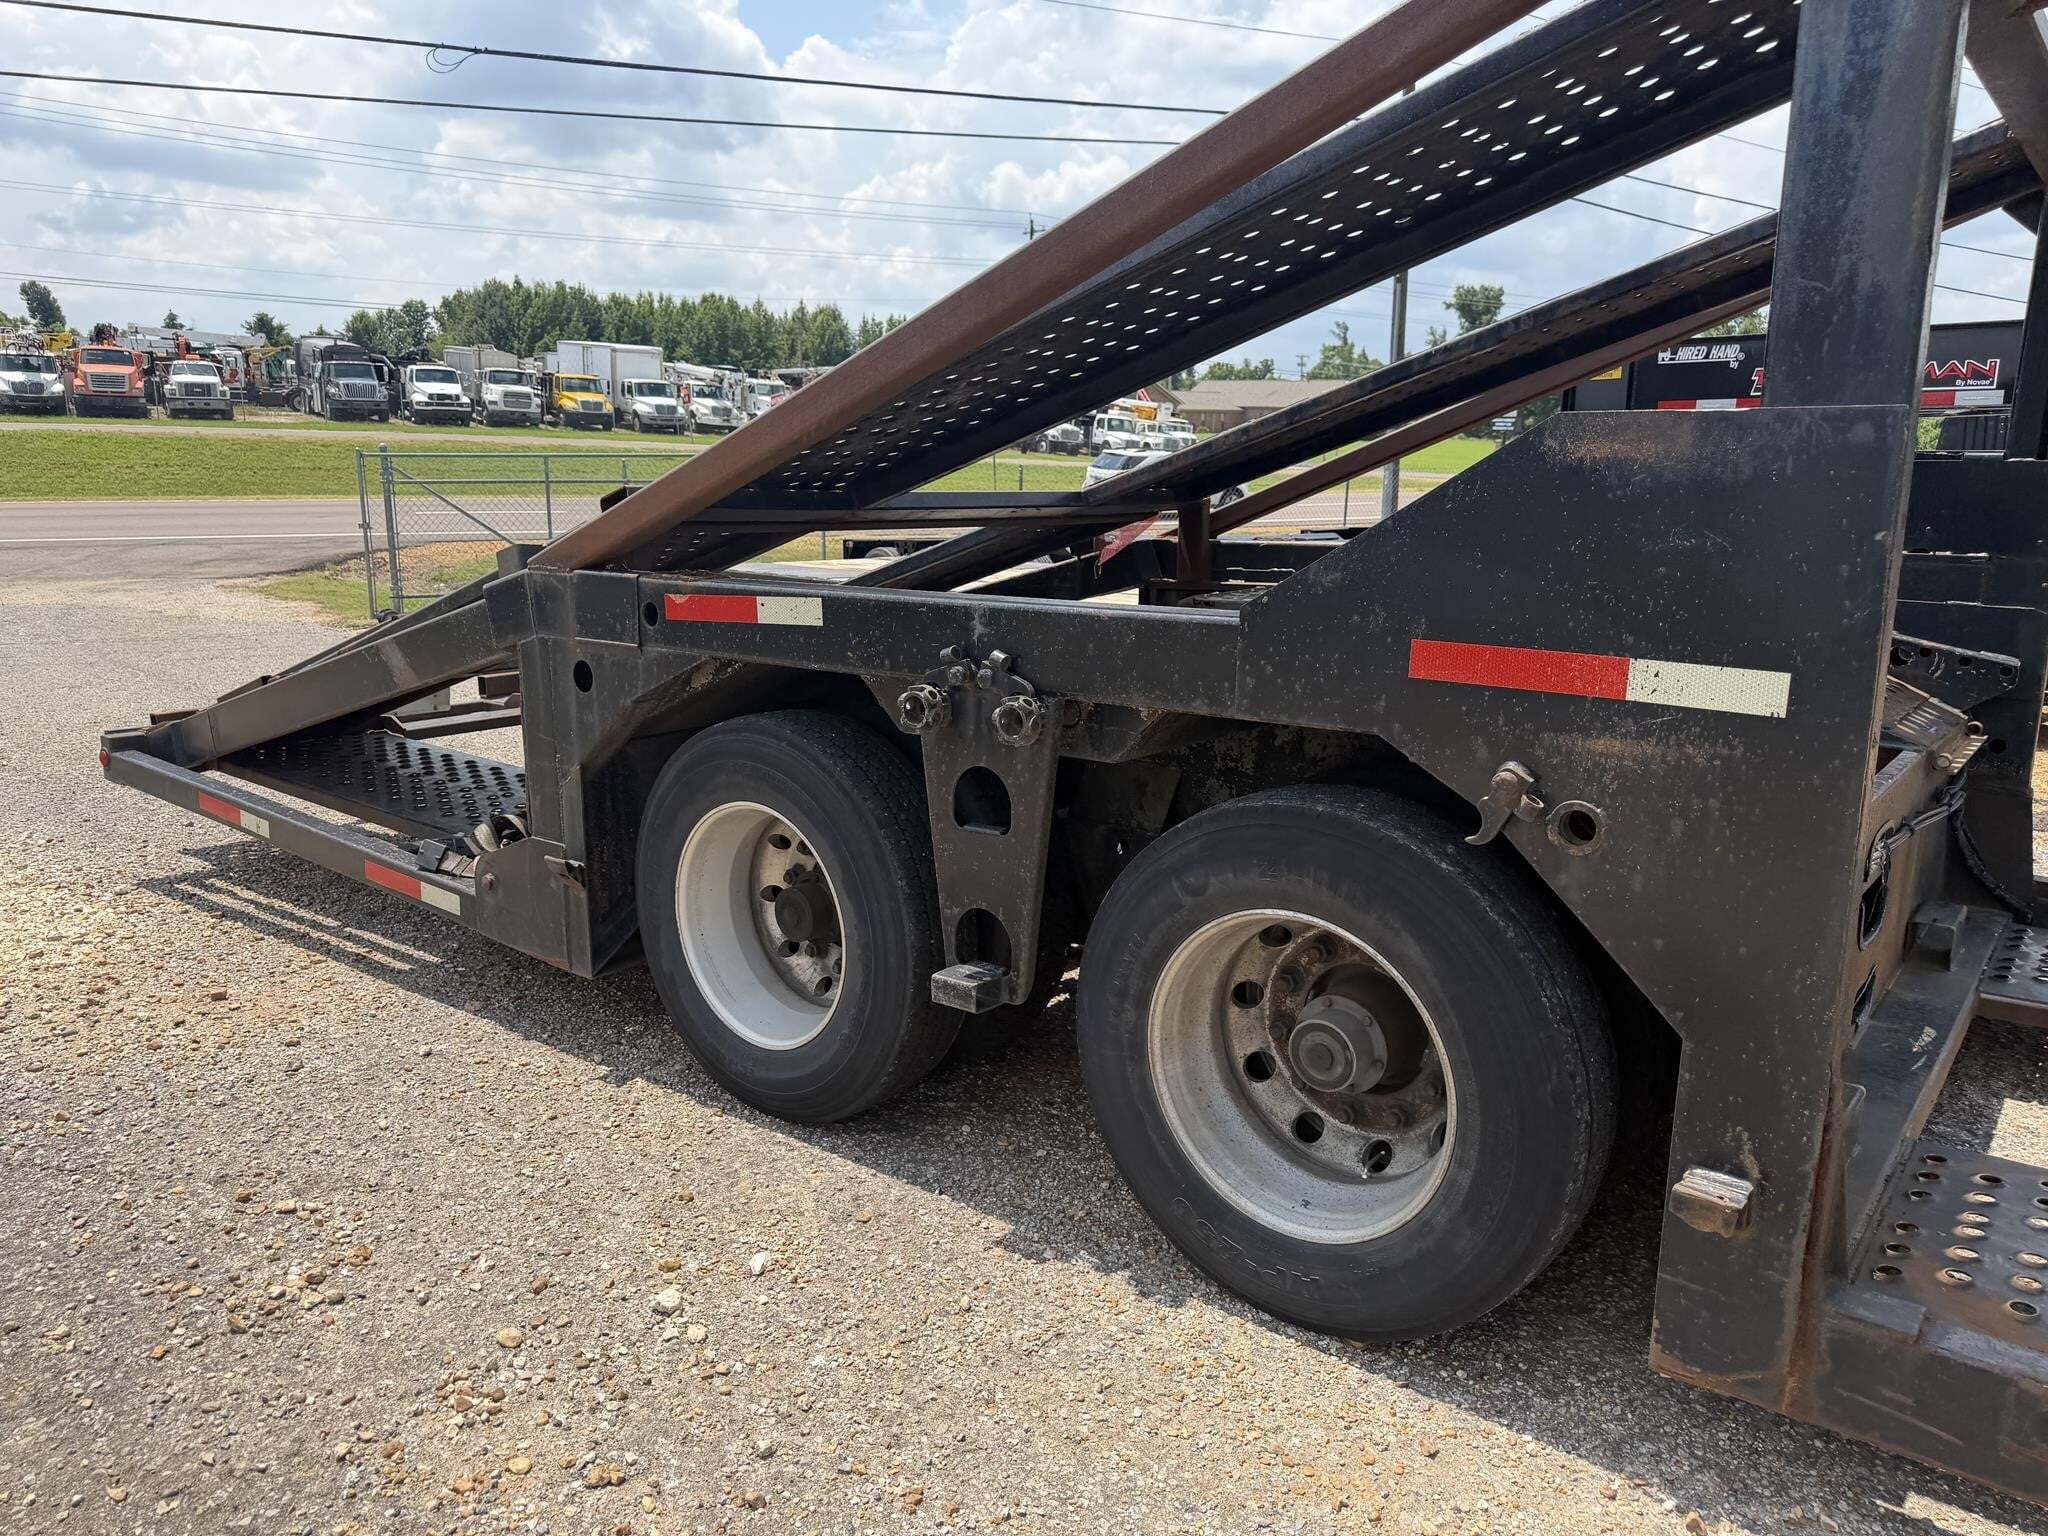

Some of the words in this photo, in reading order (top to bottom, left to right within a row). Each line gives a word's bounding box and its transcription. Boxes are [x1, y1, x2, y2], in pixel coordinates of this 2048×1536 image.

[1675, 345, 1708, 361] HIRED
[1709, 344, 1741, 359] HAND
[1729, 360, 1740, 369] by
[1955, 379, 1966, 387] By
